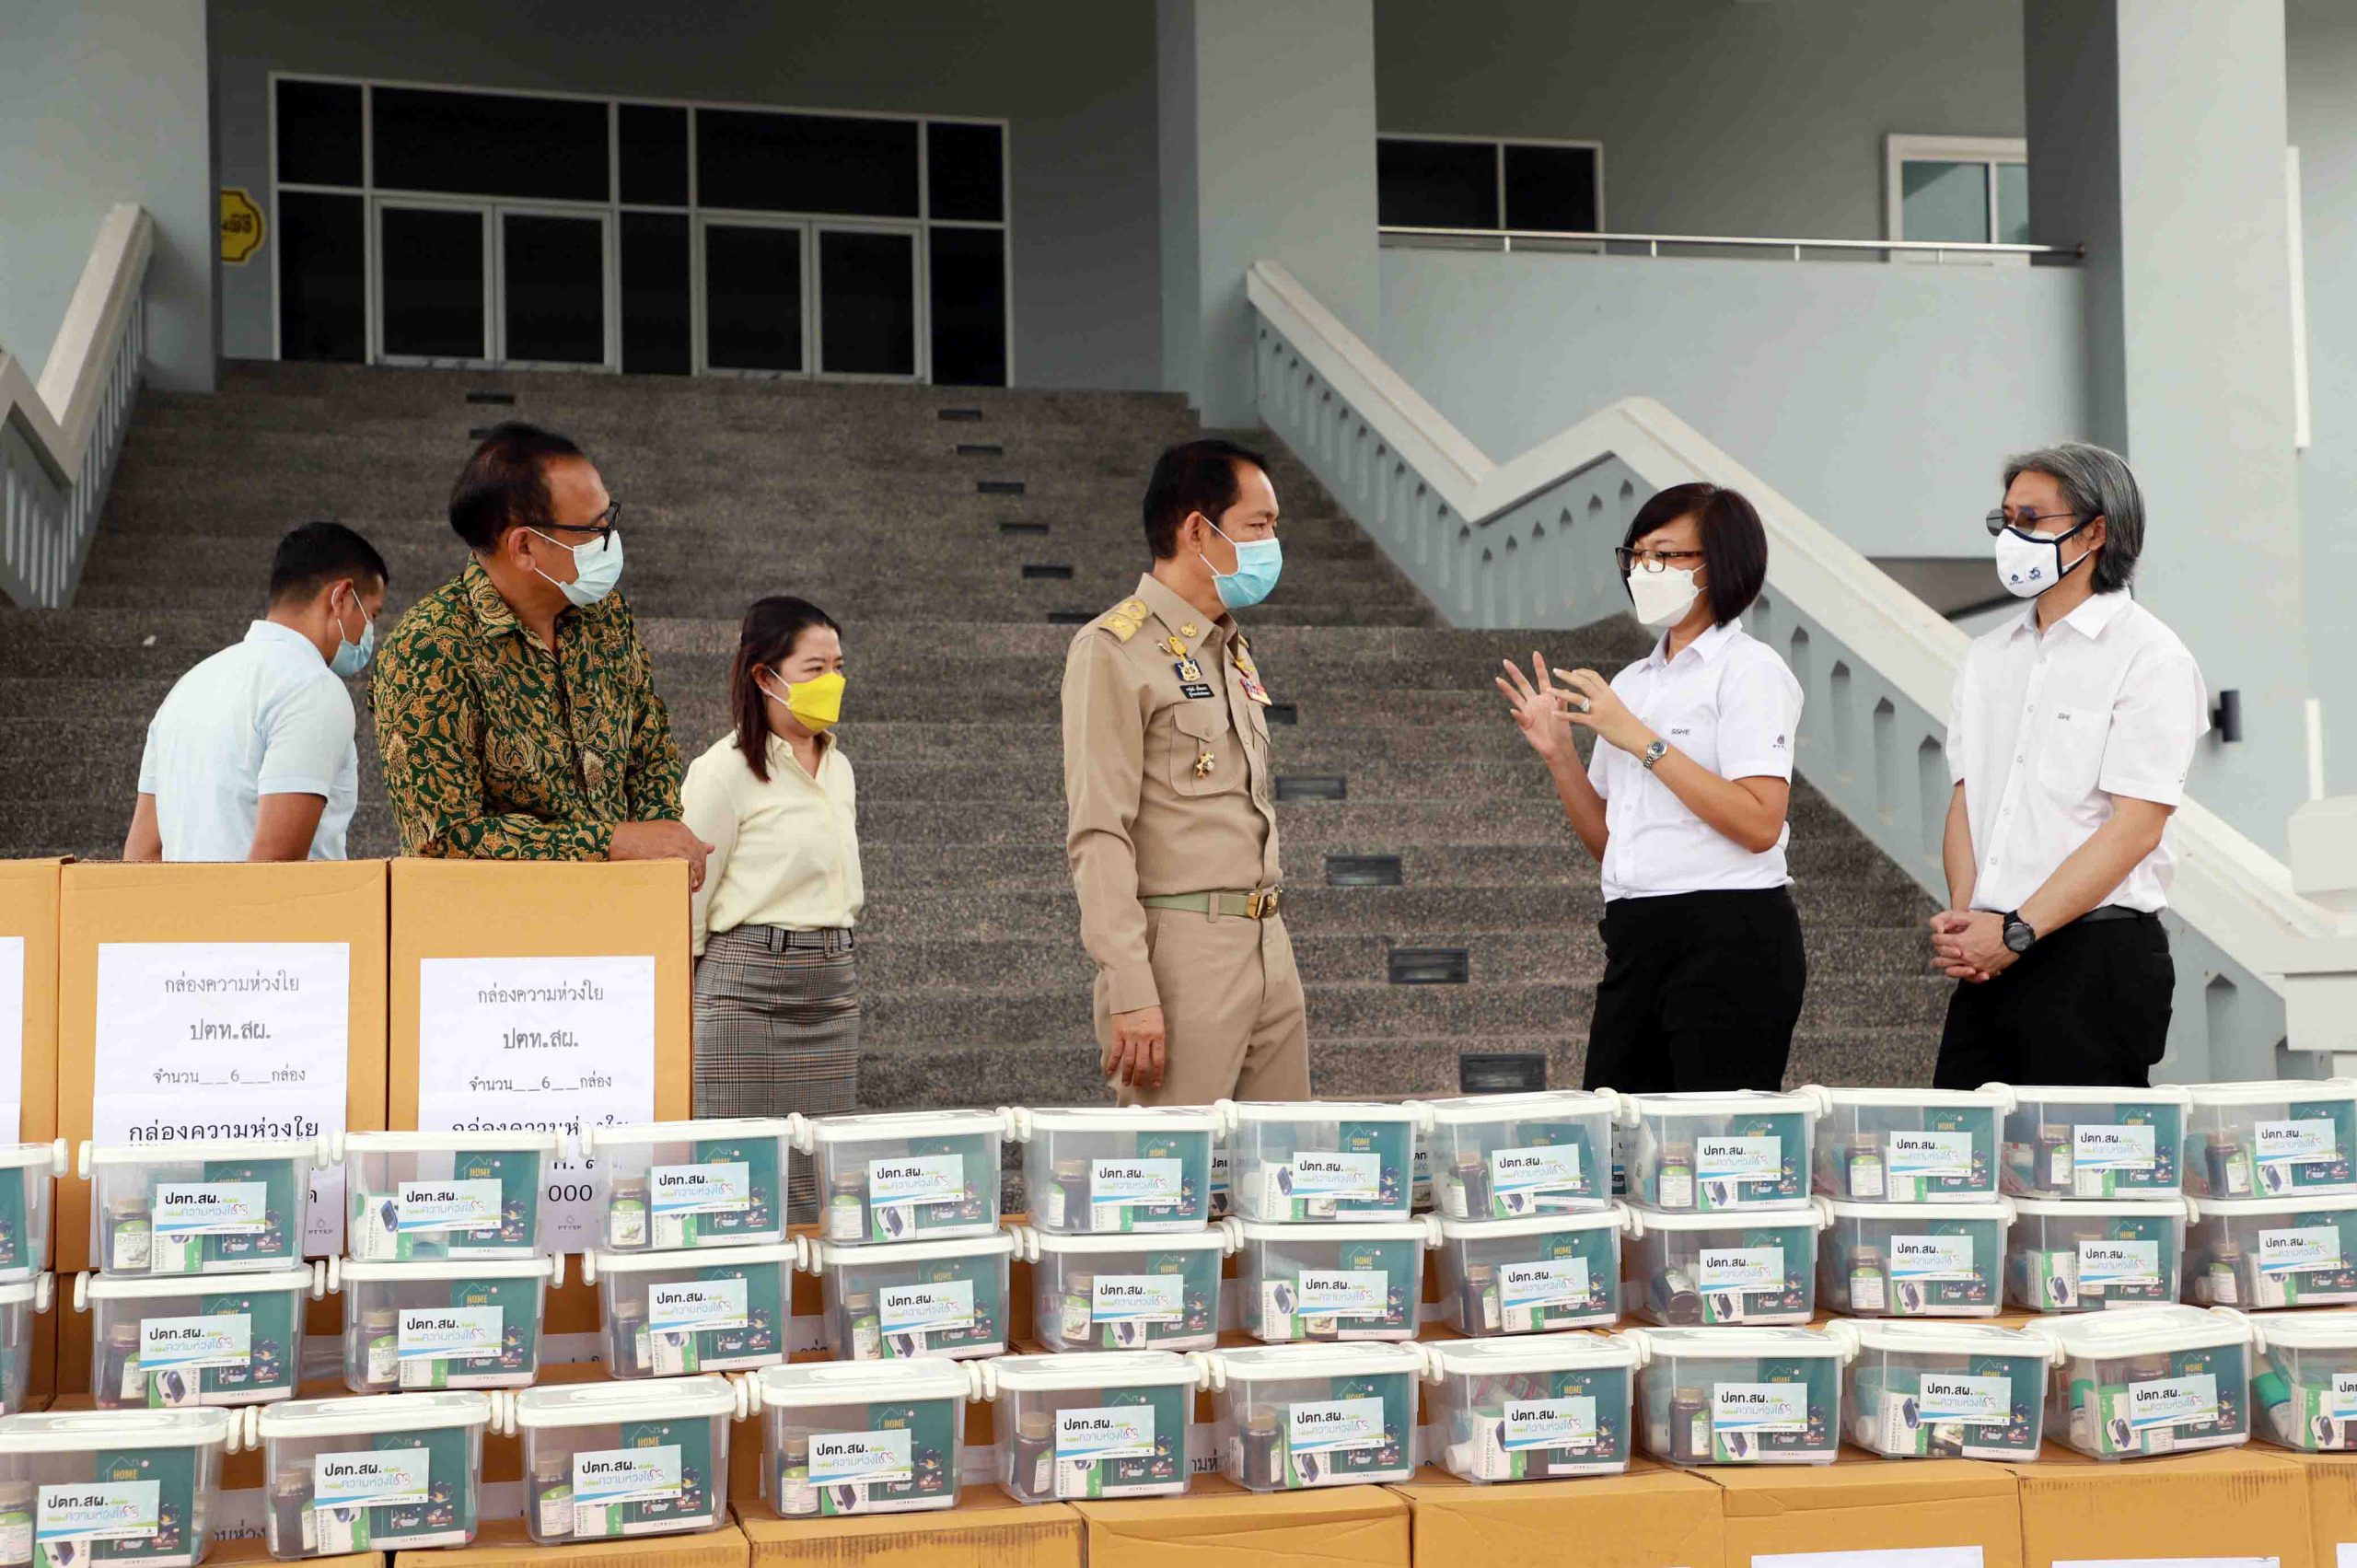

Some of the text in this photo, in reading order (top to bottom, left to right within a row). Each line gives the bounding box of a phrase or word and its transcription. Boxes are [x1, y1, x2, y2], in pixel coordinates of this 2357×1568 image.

[165, 970, 300, 993] กล่องความห่วงใย
[478, 979, 604, 1004] กล่องความห่วงใย
[190, 1018, 272, 1040] ปตท.สผ.
[503, 1028, 579, 1050] ปตท.สผ.
[2079, 1132, 2122, 1144] ปตท.สผ.
[2260, 1129, 2304, 1139] ปตท.สผ.
[1702, 1144, 1749, 1156] ปตท.สผ.
[1896, 1138, 1939, 1150] ปตท.สผ.
[1298, 1160, 1344, 1172] ปตท.สผ.
[1498, 1157, 1544, 1168] ปตท.สผ.
[876, 1167, 925, 1179] ปตท.สผ.
[1098, 1167, 1145, 1179] ปตท.สผ.
[658, 1174, 710, 1186] ปตท.สผ.
[164, 1191, 221, 1205] ปตท.สผ.
[405, 1190, 459, 1202] ปตท.สผ.
[1896, 1243, 1940, 1254] ปตท.สผ.
[2265, 1237, 2307, 1249] ปตท.สผ.
[1354, 1256, 1373, 1265] HOME
[2084, 1249, 2127, 1260] ปตท.สผ.
[1705, 1257, 1749, 1268] ปตท.สผ.
[1507, 1271, 1553, 1283] ปตท.สผ.
[1099, 1283, 1147, 1295] ปตท.สผ.
[1305, 1278, 1352, 1290] ปตท.สผ.
[467, 1295, 488, 1305] HOME
[656, 1292, 707, 1305] ปตท.สผ.
[887, 1295, 935, 1307] ปตท.สผ.
[406, 1318, 460, 1330] ปตท.สผ.
[148, 1327, 206, 1341] ปตท.สผ.
[2185, 1363, 2203, 1372] HOME
[1563, 1385, 1582, 1394] HOME
[1926, 1382, 1974, 1396] ปตท.สผ.
[2135, 1388, 2182, 1401] ปตท.สผ.
[1720, 1390, 1770, 1403] ปตท.สผ.
[1295, 1411, 1346, 1424] ปตท.สผ.
[1510, 1409, 1559, 1422] ปตท.สผ.
[883, 1419, 905, 1429] HOME
[1062, 1418, 1115, 1431] ปตท.สผ.
[637, 1438, 660, 1447] HOME
[816, 1443, 869, 1457] ปตท.สผ.
[323, 1463, 383, 1477] ปตท.สผ.
[581, 1460, 637, 1474] ปตท.สผ.
[113, 1469, 138, 1480] HOME
[47, 1494, 110, 1509] ปตท.สผ.
